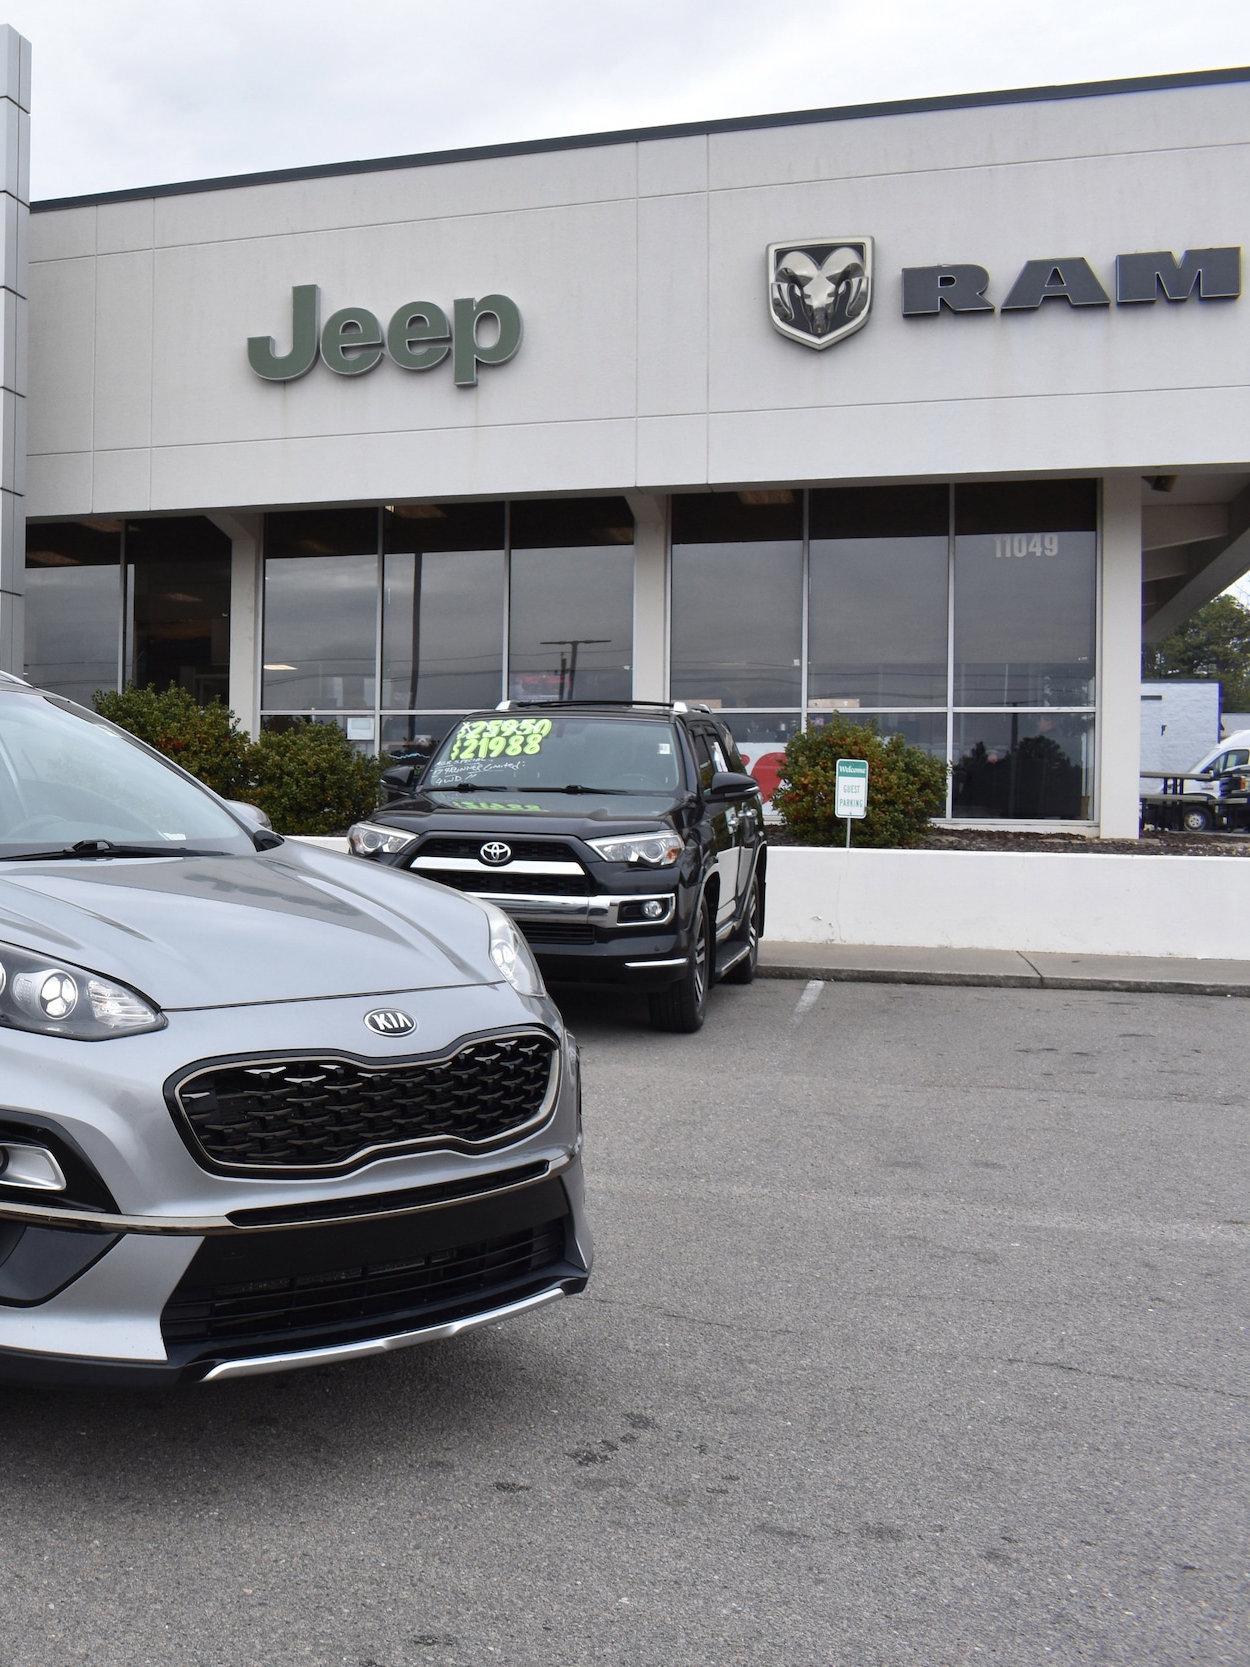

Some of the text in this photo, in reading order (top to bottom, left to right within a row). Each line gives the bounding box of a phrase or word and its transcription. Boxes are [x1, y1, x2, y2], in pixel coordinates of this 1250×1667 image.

[901, 246, 1242, 318] RAM
[247, 284, 522, 387] Jeep
[993, 533, 1059, 558] 11049
[451, 734, 542, 760] $21988
[839, 765, 866, 774] Welcome
[843, 785, 860, 794] GUEST
[839, 798, 863, 808] PARKING
[371, 1012, 413, 1031] KIA
